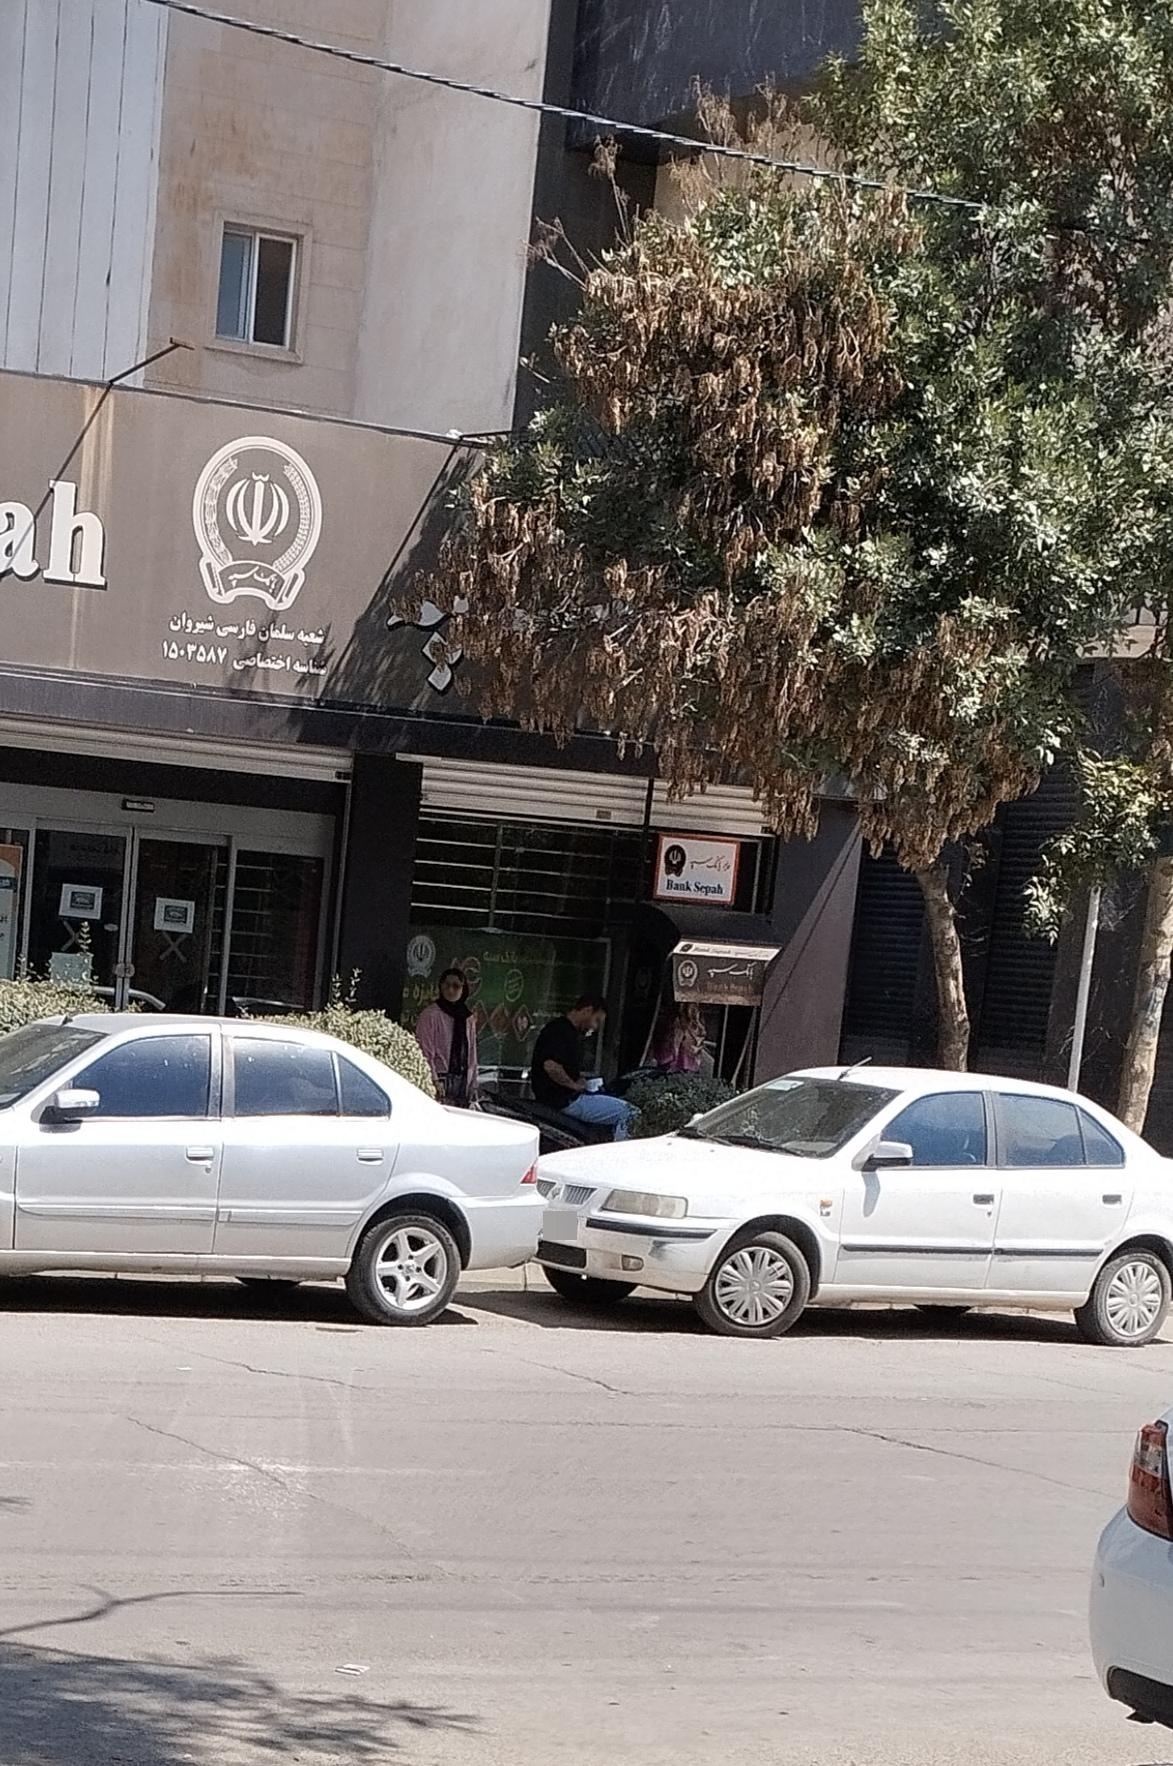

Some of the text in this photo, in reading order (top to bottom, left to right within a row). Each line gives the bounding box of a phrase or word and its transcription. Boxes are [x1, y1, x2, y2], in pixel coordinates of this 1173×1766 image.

[169, 610, 325, 647] شعبه سلمان فارسی شیروان
[233, 652, 291, 671] اختصاصی
[293, 658, 328, 676] شناسه
[666, 879, 723, 896] Bank Sepah
